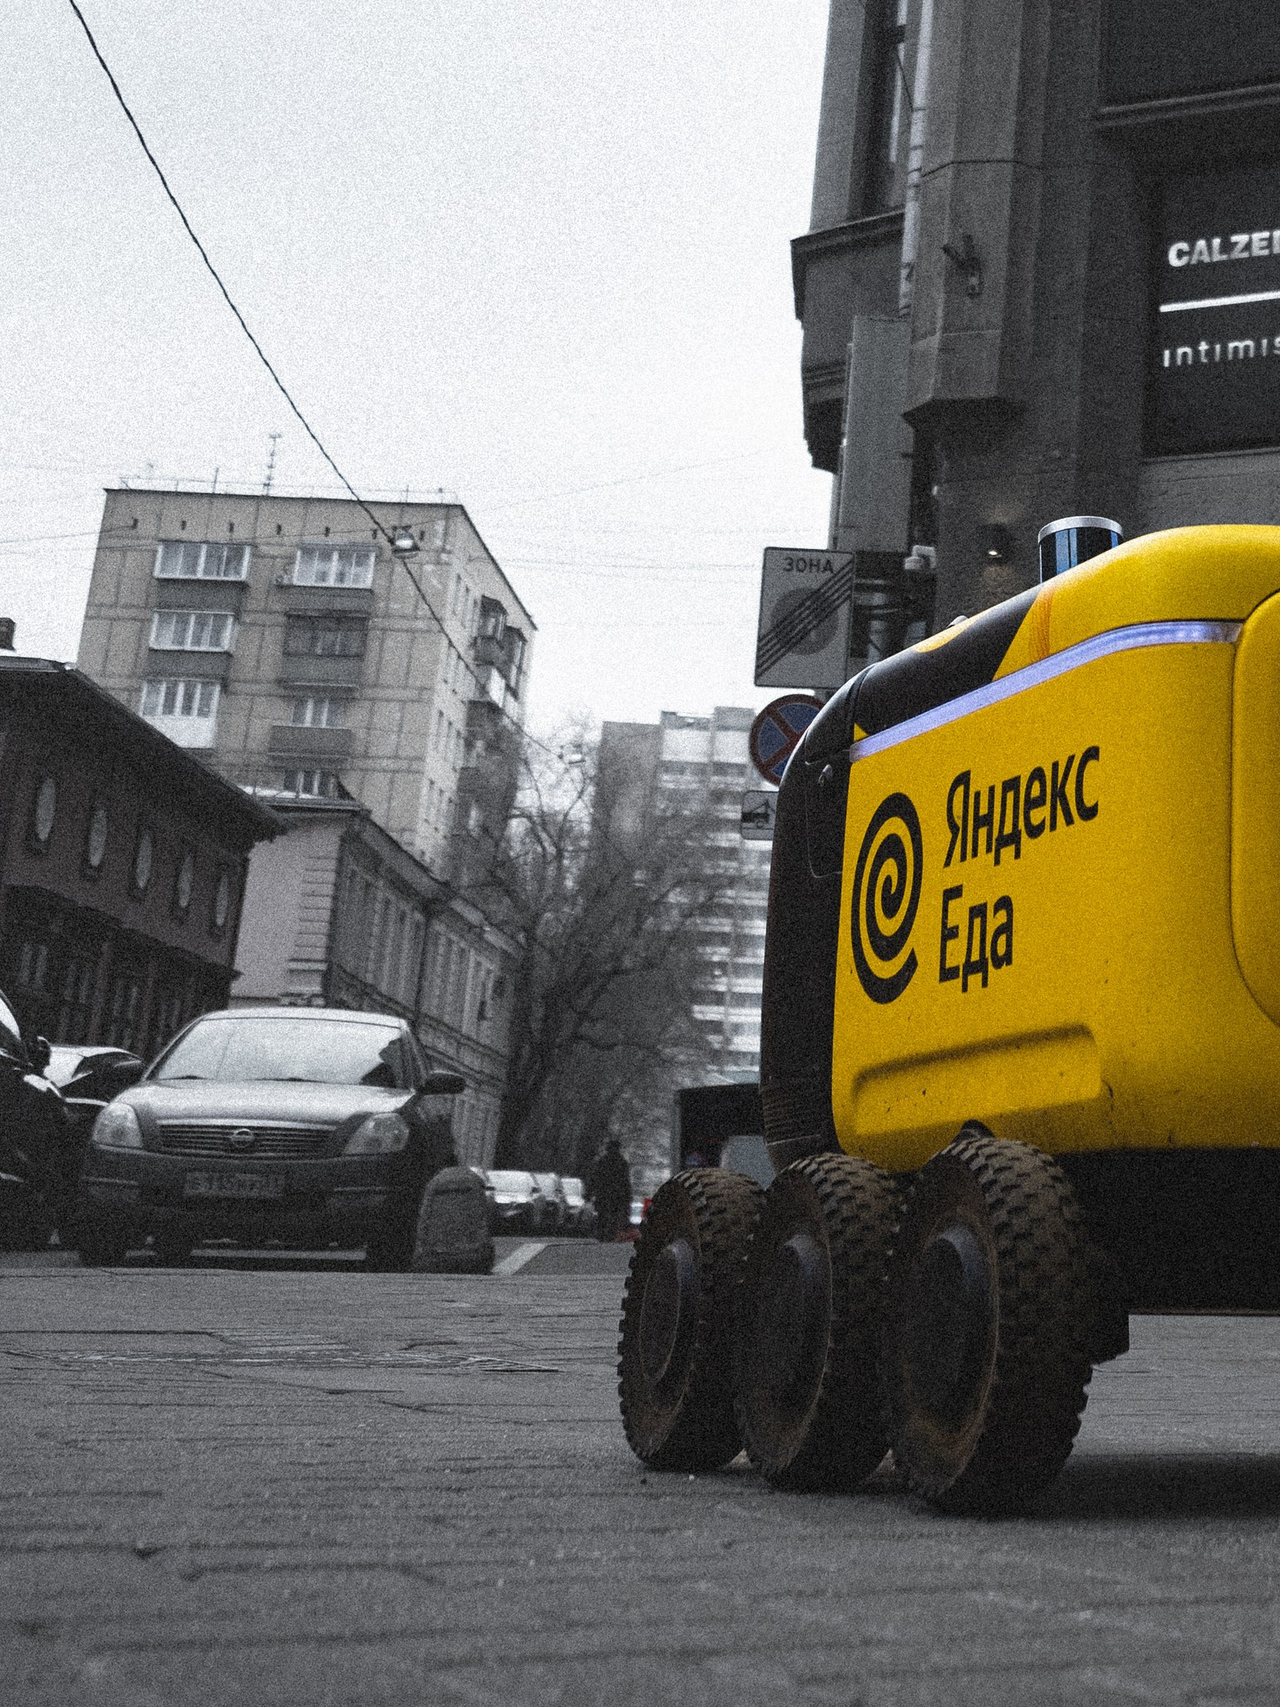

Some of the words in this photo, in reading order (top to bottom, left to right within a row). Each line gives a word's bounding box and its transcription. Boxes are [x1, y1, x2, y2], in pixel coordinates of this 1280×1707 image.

[782, 556, 835, 574] ЗОНА
[943, 745, 1100, 869] Яндекс
[938, 884, 1014, 993] Еда
